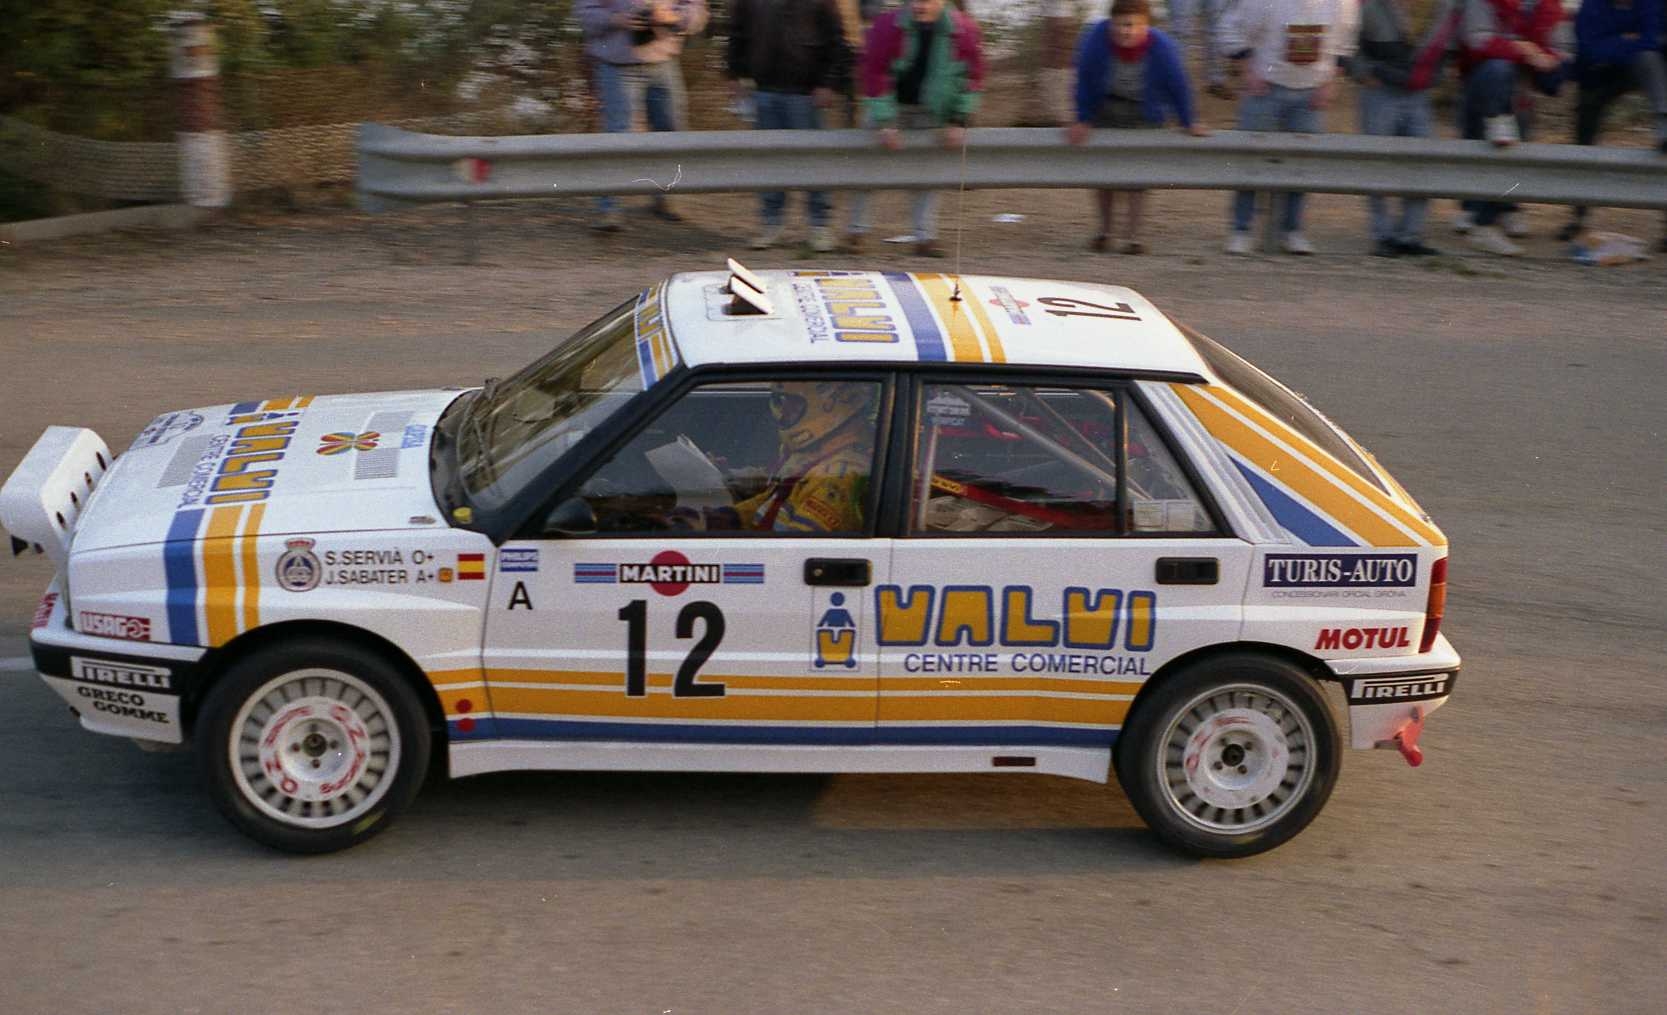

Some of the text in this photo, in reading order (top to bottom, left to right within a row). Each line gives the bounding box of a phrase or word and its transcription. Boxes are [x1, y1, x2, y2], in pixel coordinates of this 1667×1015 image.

[1036, 297, 1143, 321] 12
[324, 547, 435, 566] S.SERVIÀ O+
[324, 569, 435, 585] J.SABATER A+
[621, 564, 719, 582] MARTINI
[1268, 558, 1414, 583] TURIS-AUTO
[508, 581, 533, 610] A
[874, 585, 1157, 651] VALVI
[618, 600, 726, 697] 12
[1314, 627, 1411, 650] MOTUL
[70, 656, 172, 688] PIRELLI
[903, 654, 1152, 676] CENTRE COMERCIAL
[77, 686, 145, 707] GRECO
[1351, 673, 1449, 699] PIRELLI
[93, 700, 170, 724] GOMME
